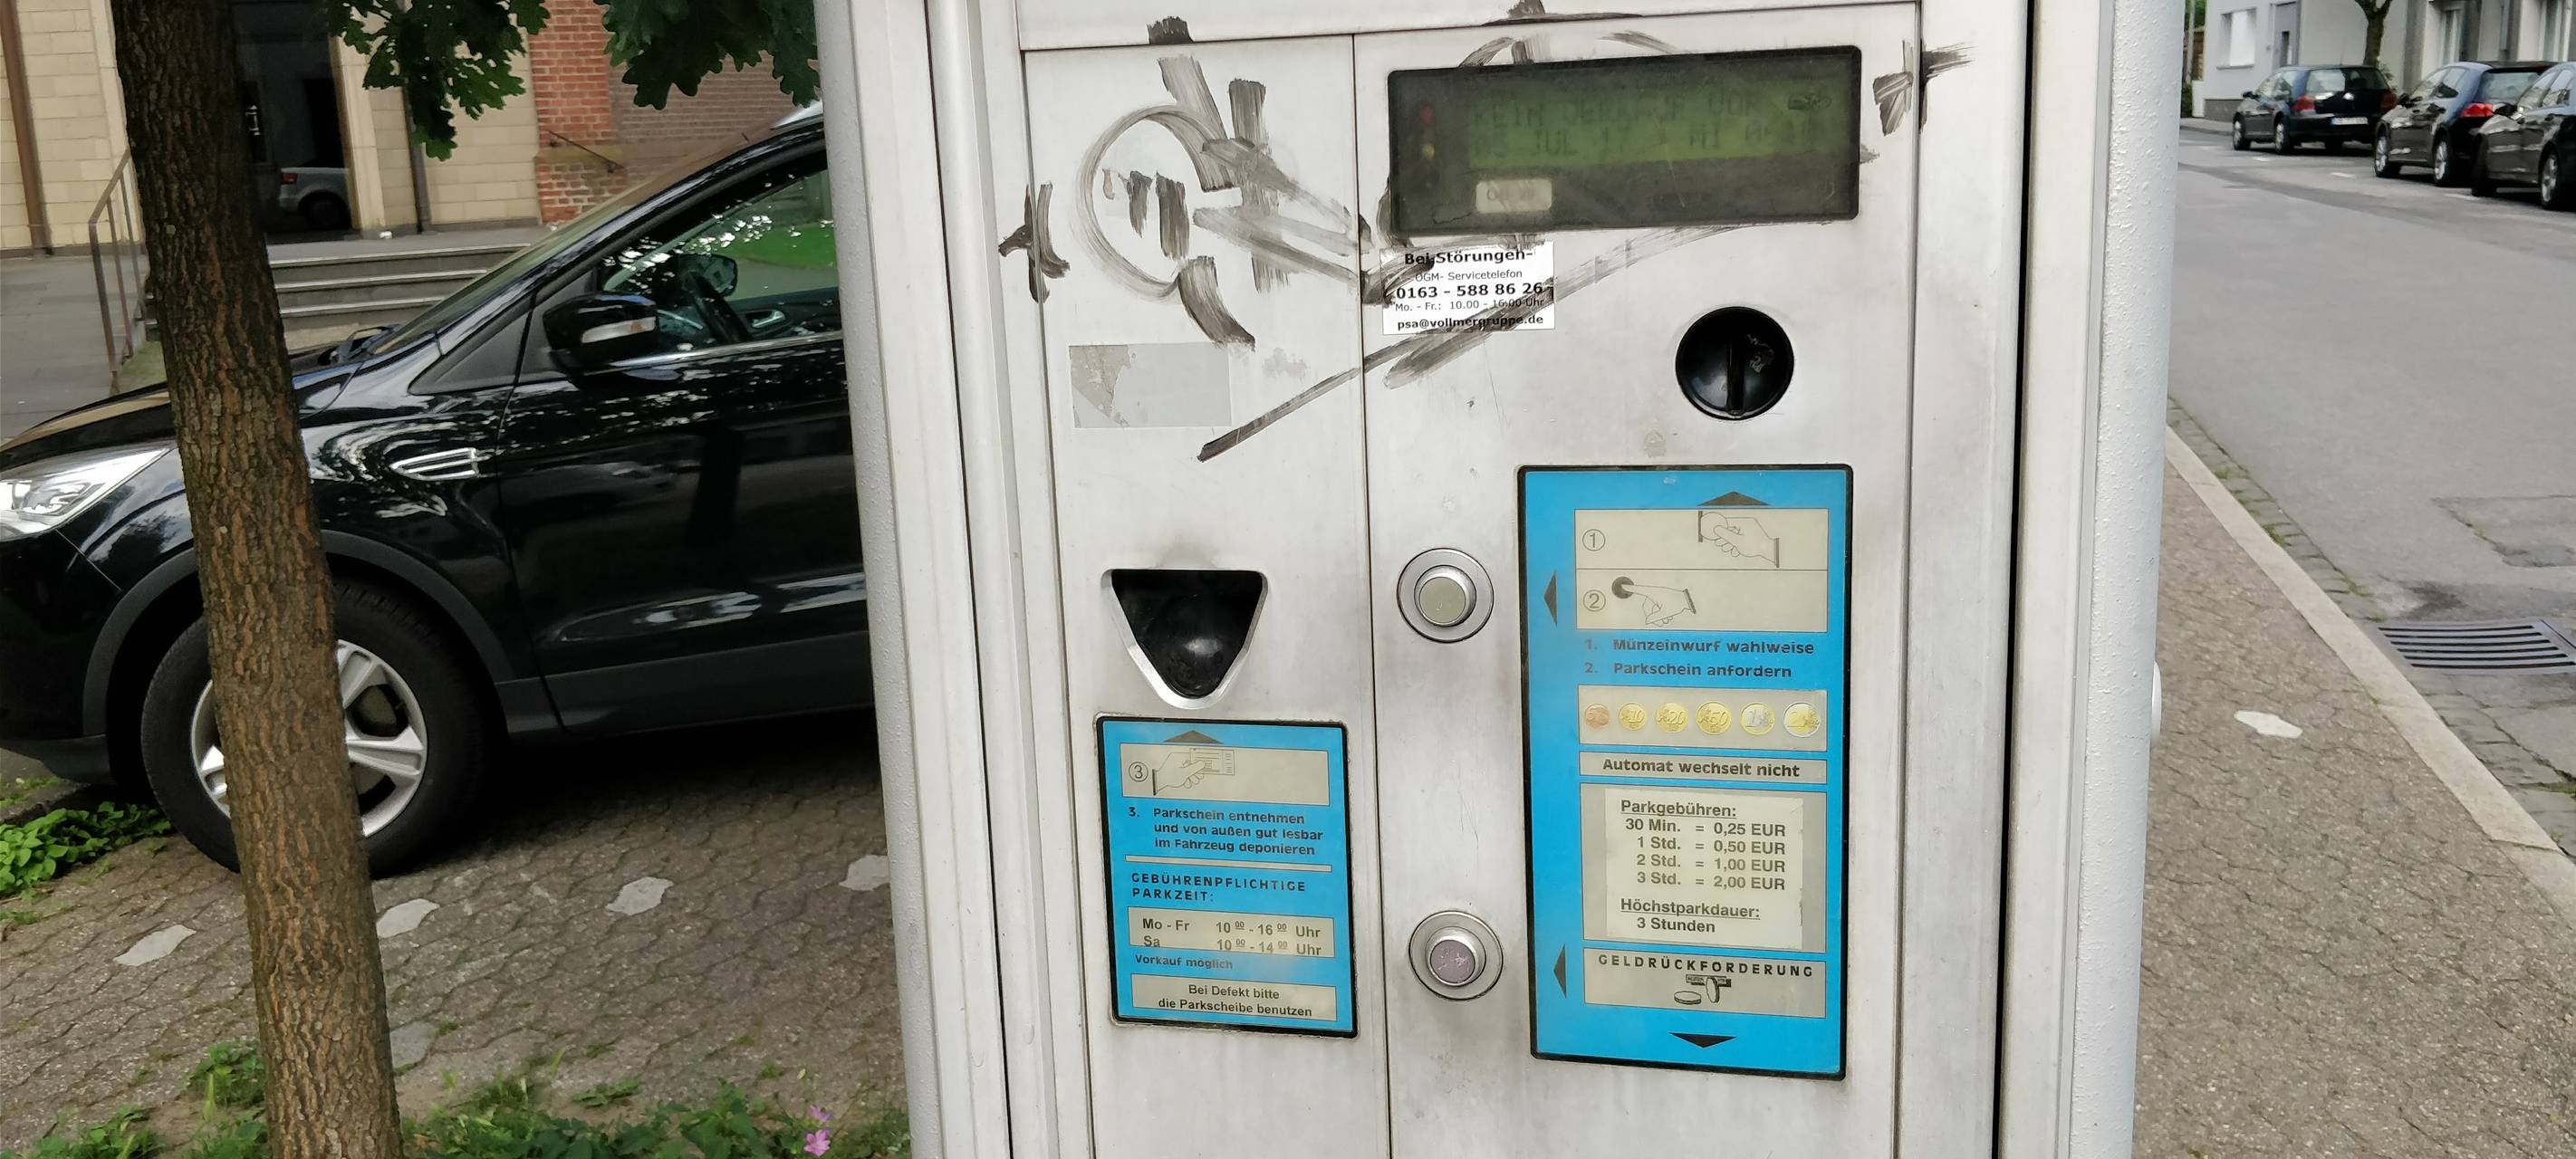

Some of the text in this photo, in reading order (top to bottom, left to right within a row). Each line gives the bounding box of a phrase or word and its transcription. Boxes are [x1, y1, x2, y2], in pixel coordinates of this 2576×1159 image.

[1448, 269, 1523, 281] Servicetelefon
[1397, 286, 1437, 299] 0163
[1456, 284, 1488, 297] 588
[1495, 283, 1515, 295] 86
[1523, 282, 1543, 294] 26
[1396, 303, 1412, 311] Mo.
[1450, 300, 1479, 310] 10.00
[1525, 298, 1544, 307] Uhr
[1398, 314, 1543, 332] psa@vollmergruppe.de
[1613, 638, 1720, 653] Münzeinwurf
[1726, 640, 1814, 655] wahlweise
[1585, 662, 1792, 678] 2. Parkschein anfordern
[1603, 759, 1800, 778] Automat wechselt nicht
[1129, 806, 1304, 824] 3. Parkschein entnehmen
[1621, 800, 1736, 817] Parkgebühren:
[1154, 824, 1323, 840] und von außen gut lesbar
[1626, 818, 1644, 830] 30
[1648, 819, 1681, 832] Min.
[1714, 822, 1746, 837] 0,25
[1751, 823, 1786, 837] EUR
[1155, 838, 1315, 856] im Fahrzeug deponieren
[1638, 837, 1644, 848] 1
[1650, 836, 1681, 850] Std.
[1714, 839, 1746, 854] 0,50
[1751, 841, 1786, 855] EUR
[1637, 854, 1646, 866] 2
[1650, 854, 1681, 867] Std.
[1715, 857, 1746, 872] 1,00
[1751, 859, 1786, 873] EUR
[1131, 872, 1305, 892] GEBÜHRENPFLICHTIGE
[1637, 871, 1646, 884] 3
[1650, 871, 1681, 886] Std.
[1714, 876, 1746, 890] 2,00
[1751, 876, 1786, 890] EUR
[1132, 887, 1214, 902] PARKZEIT:
[1621, 897, 1760, 919] Höchstparkdauer:
[1142, 918, 1163, 930] Mo
[1176, 920, 1189, 931] Fr
[1295, 925, 1321, 938] Uhr
[1637, 917, 1716, 933] 3 Stunden
[1143, 935, 1160, 947] Sa
[1296, 943, 1322, 955] Uhr
[1135, 954, 1233, 970] Vorkauf möglich
[1599, 954, 1812, 977] GELDRÜCKFORDERUNG
[1188, 984, 1280, 1000] Bei Defekt bitte
[1158, 998, 1312, 1017] die Parkscheibe benutzen
